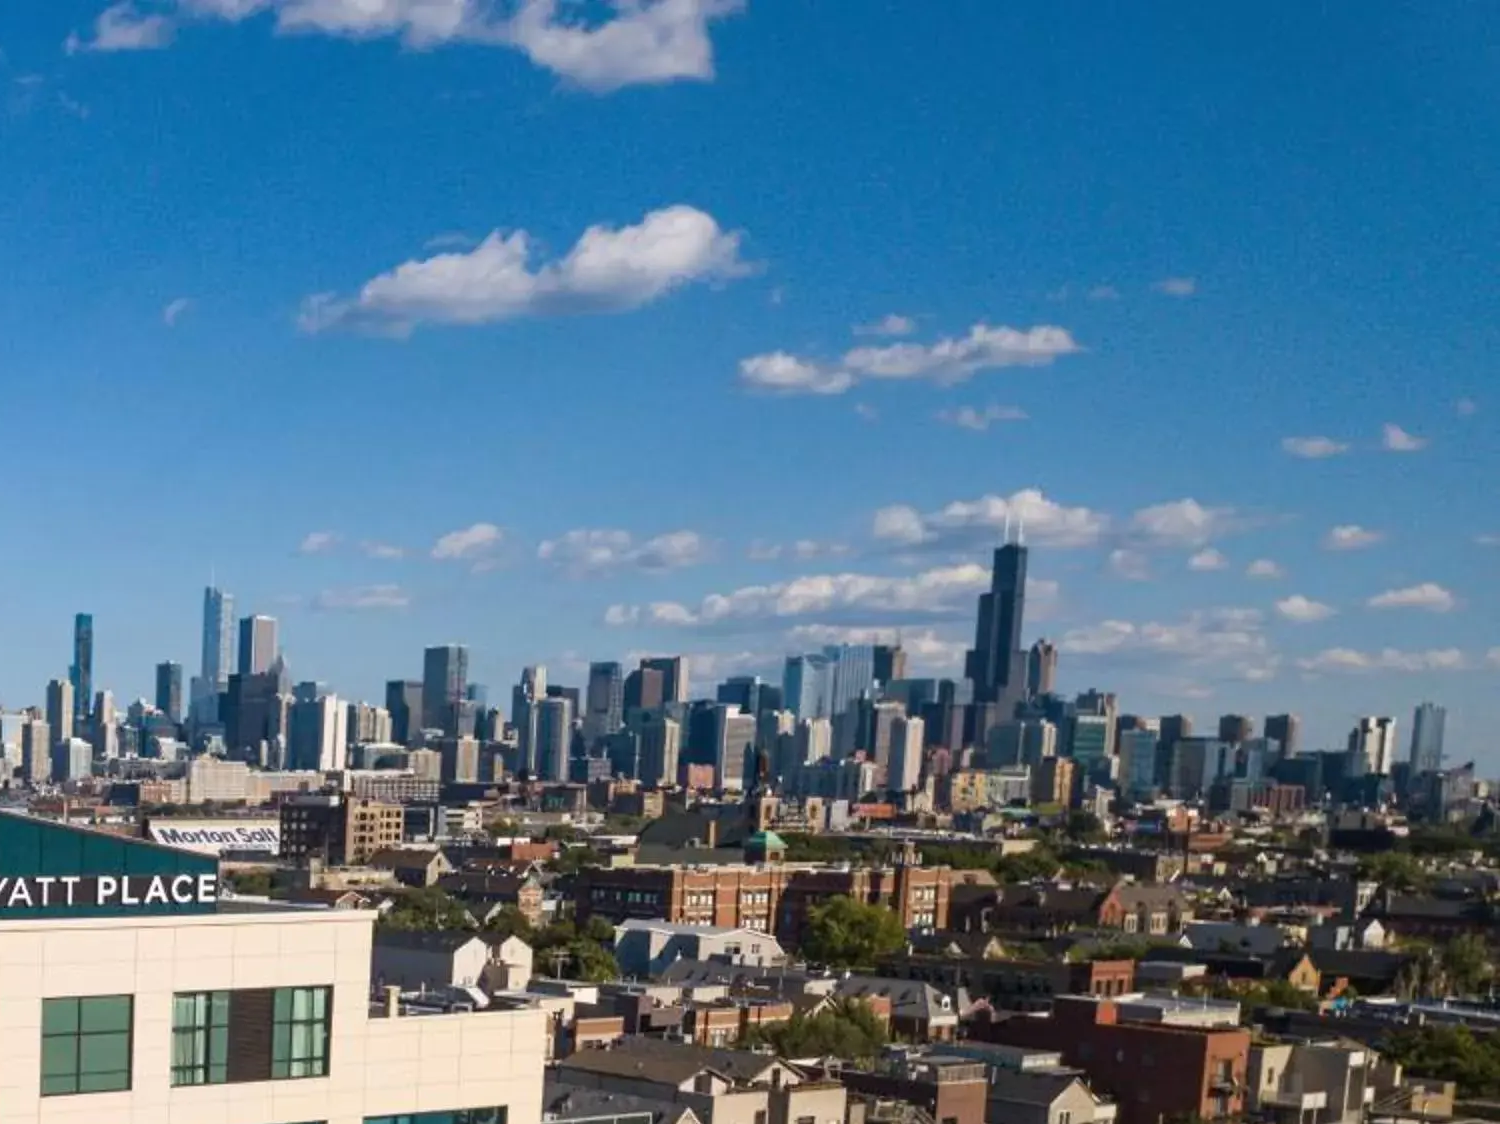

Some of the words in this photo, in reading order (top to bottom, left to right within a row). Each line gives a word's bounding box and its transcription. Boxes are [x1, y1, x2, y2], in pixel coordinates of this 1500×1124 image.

[159, 827, 237, 844] Morton
[236, 827, 278, 843] Salt
[97, 874, 217, 905] PLACE
